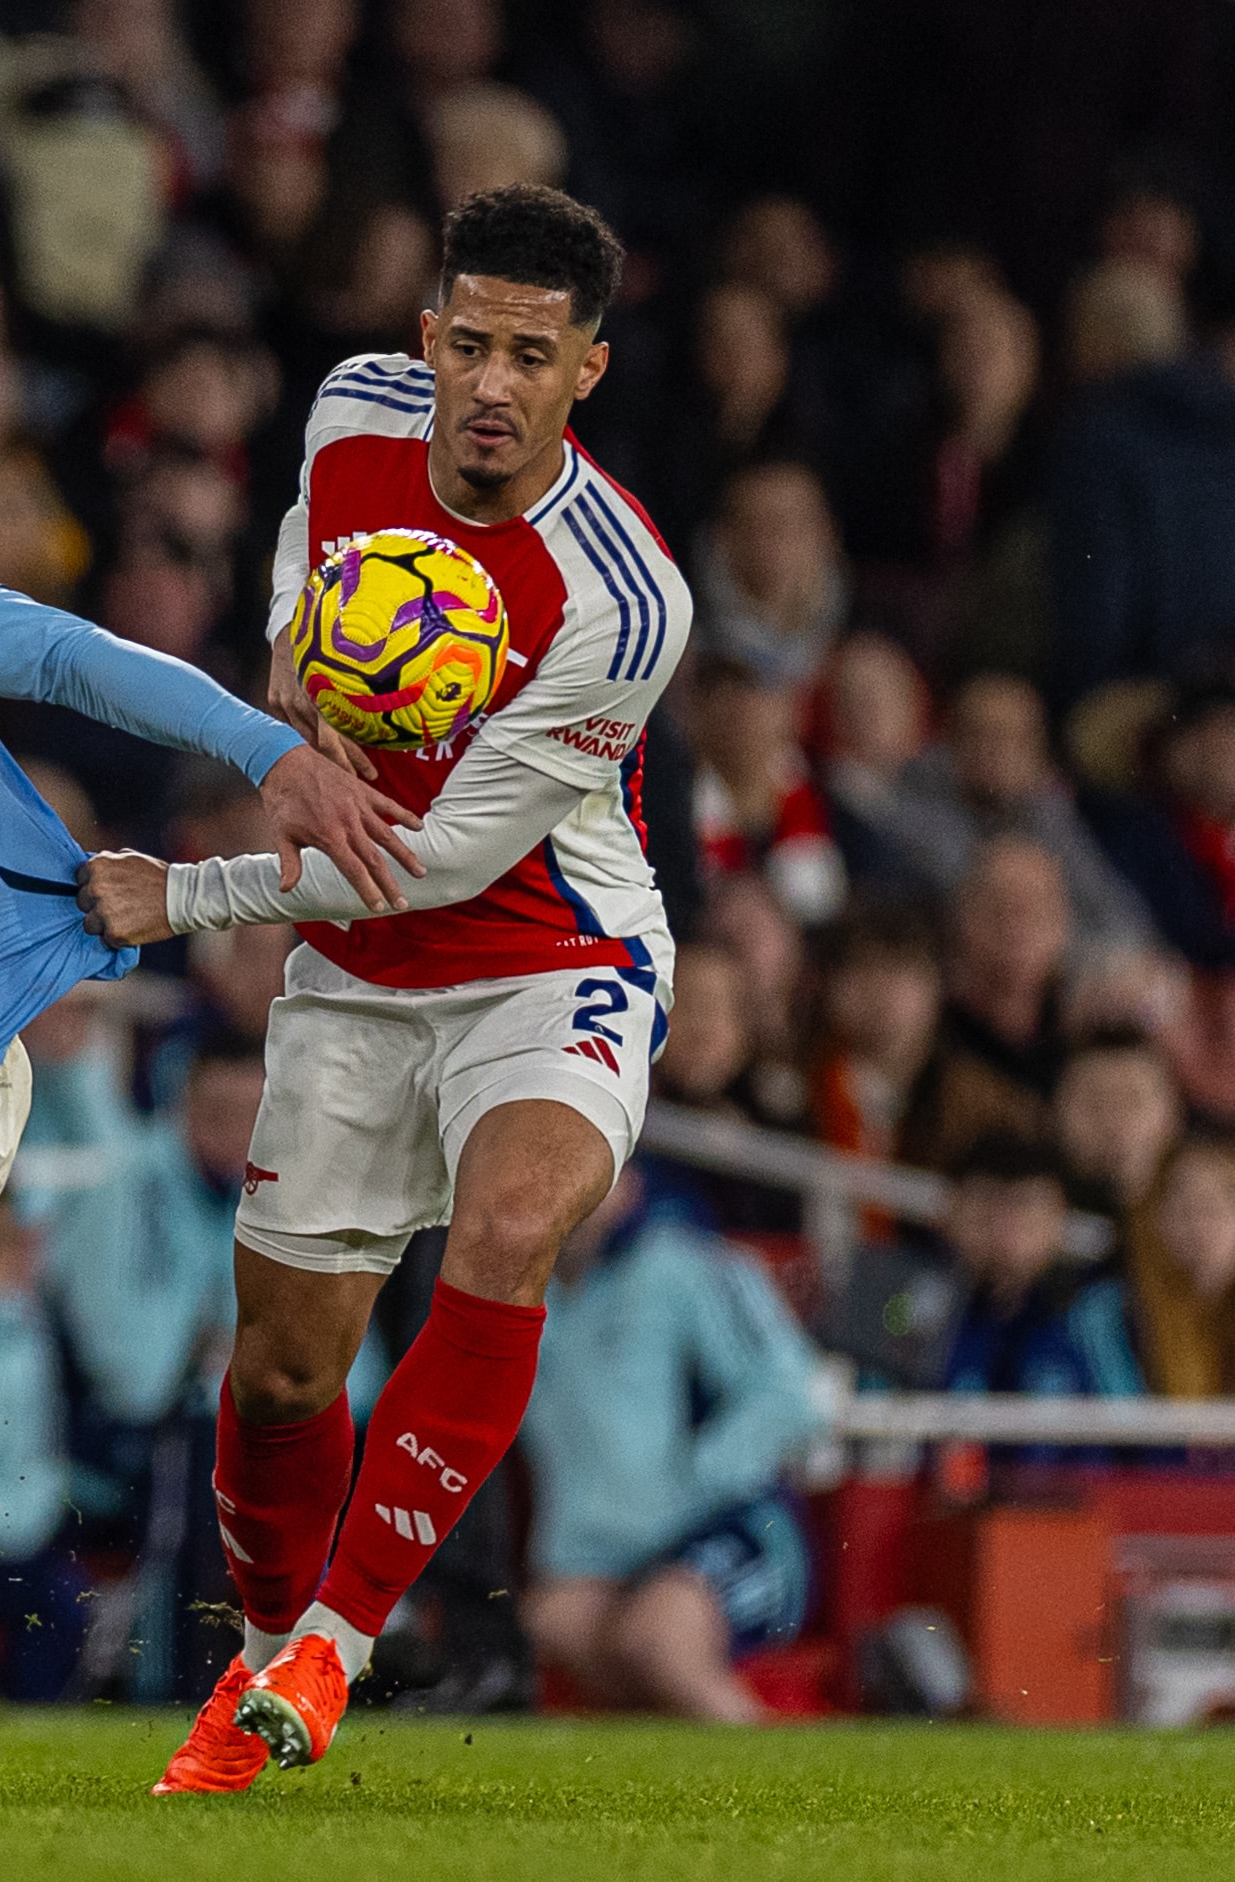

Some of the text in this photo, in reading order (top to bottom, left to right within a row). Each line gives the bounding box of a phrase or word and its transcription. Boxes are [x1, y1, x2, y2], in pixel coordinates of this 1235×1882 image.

[585, 717, 635, 741] VISIT
[572, 978, 629, 1048] 2
[396, 1432, 468, 1493] AFC
